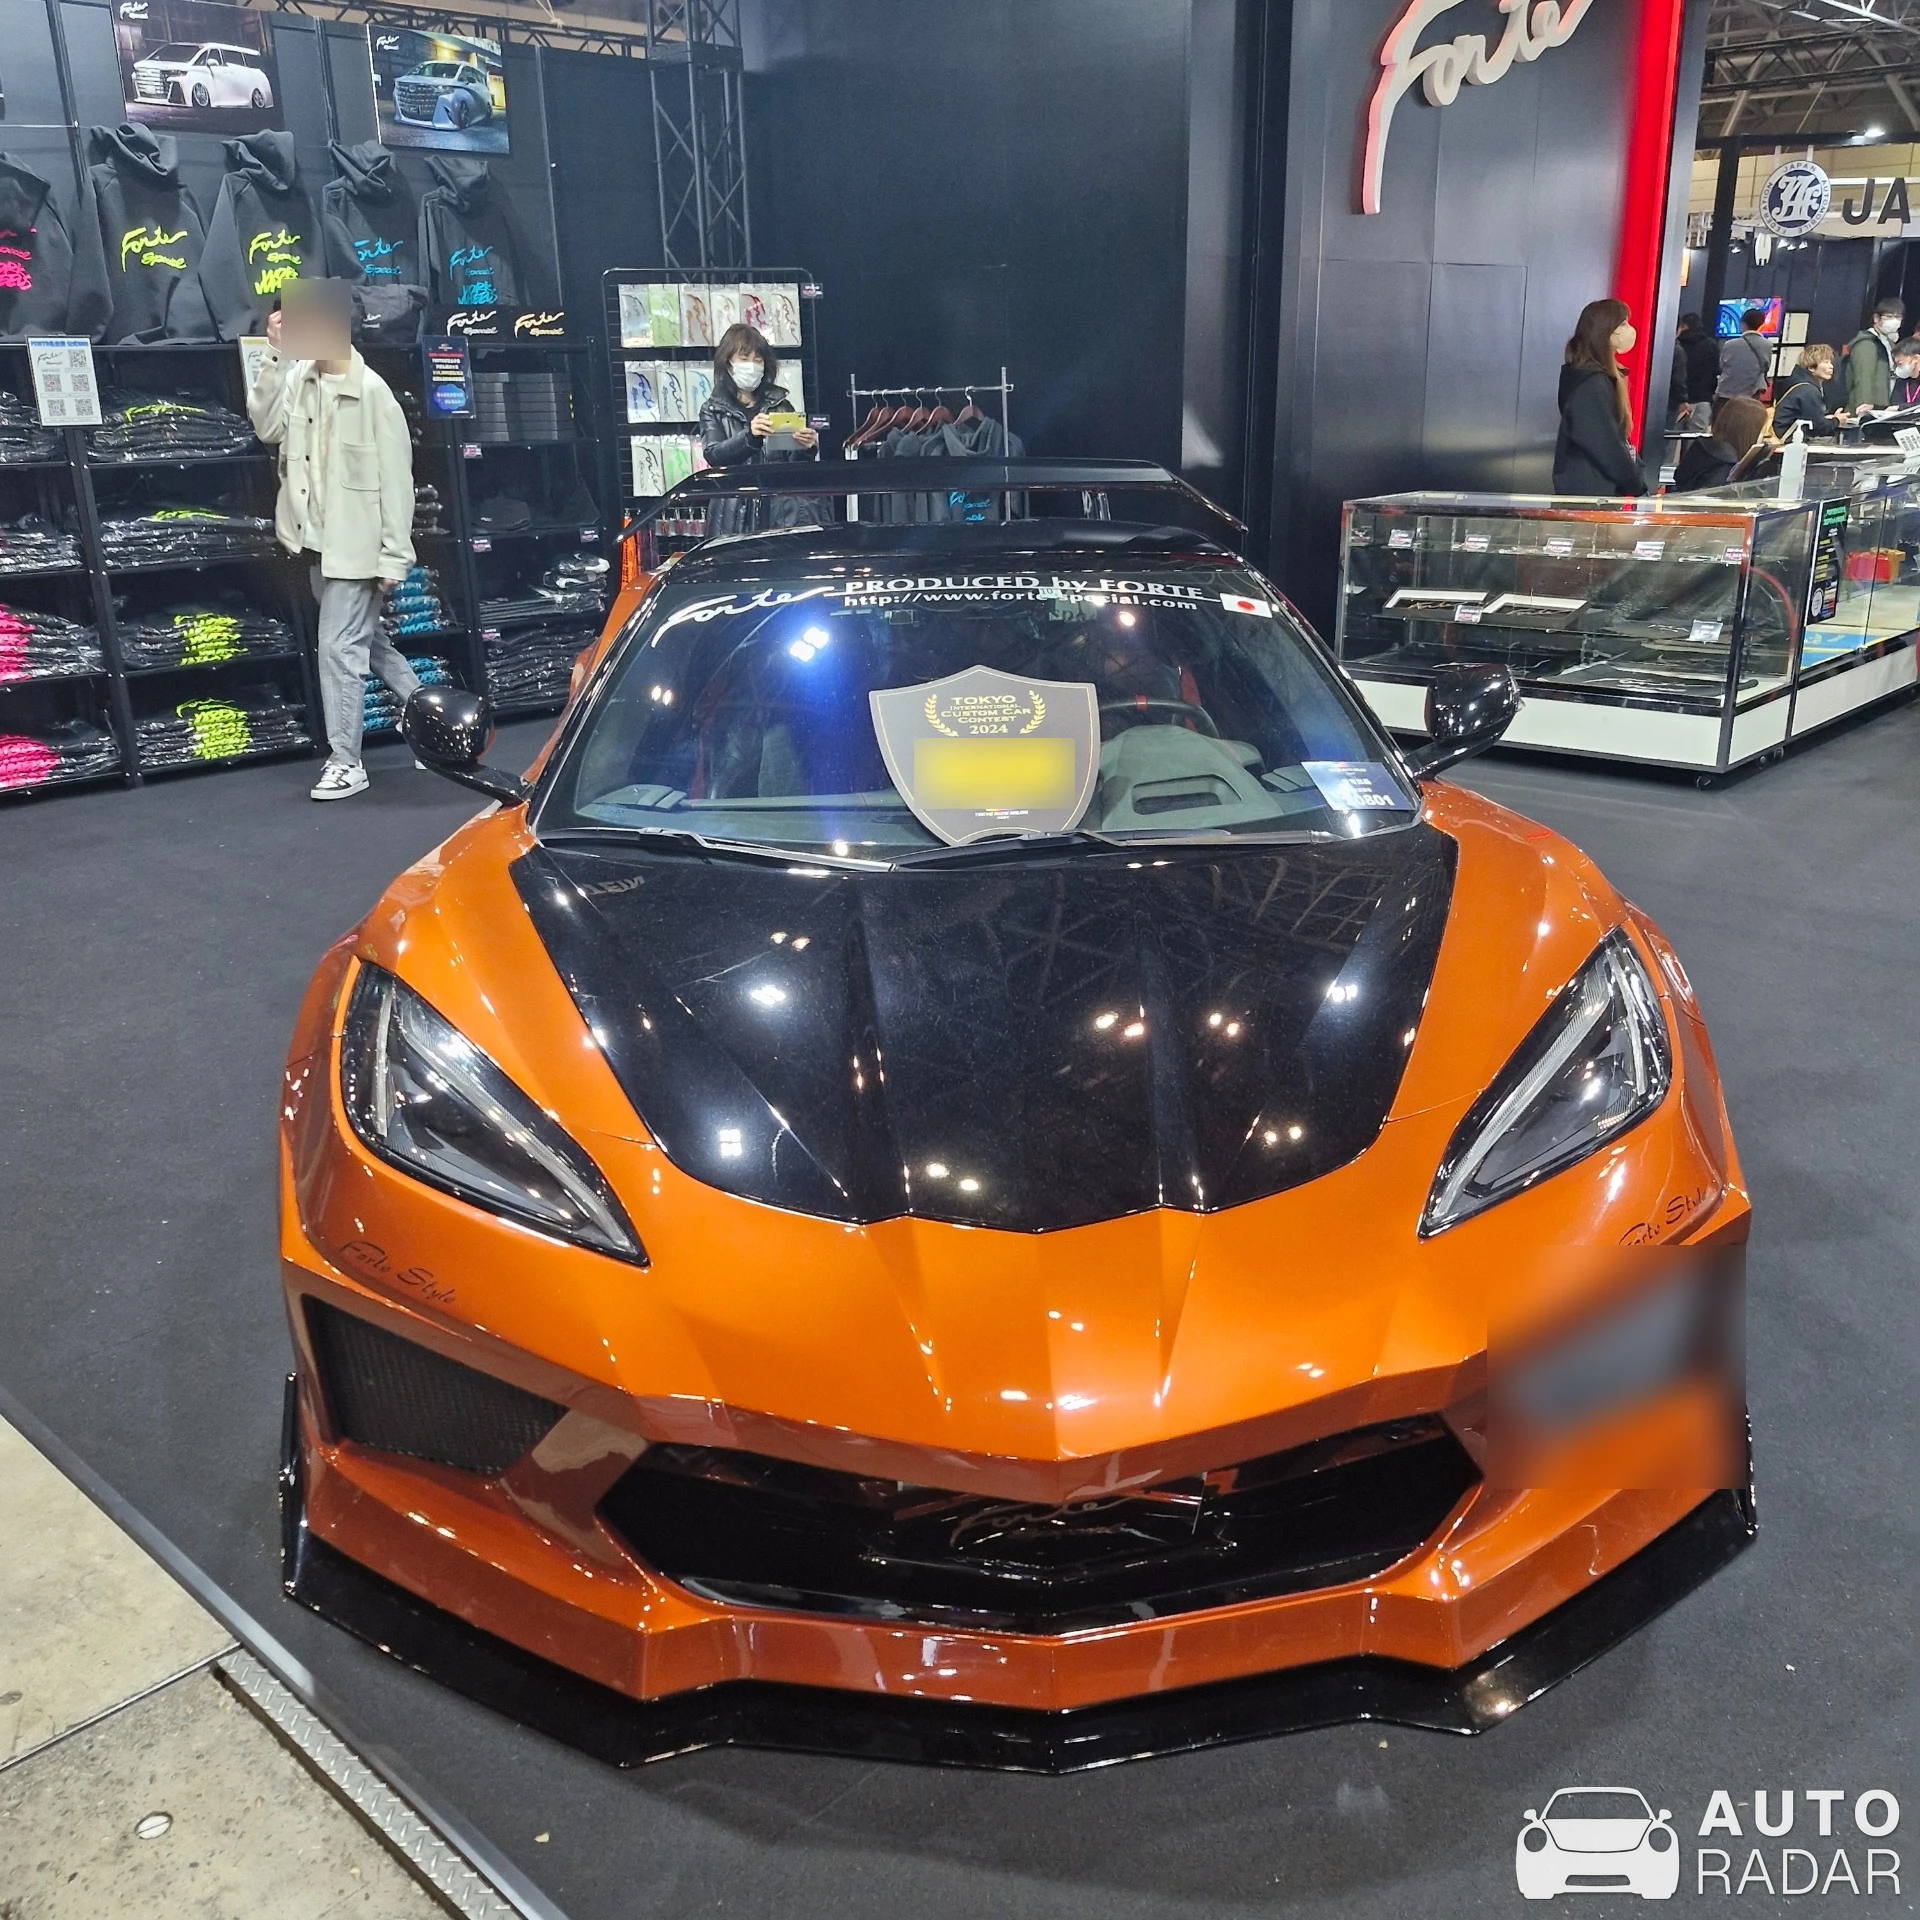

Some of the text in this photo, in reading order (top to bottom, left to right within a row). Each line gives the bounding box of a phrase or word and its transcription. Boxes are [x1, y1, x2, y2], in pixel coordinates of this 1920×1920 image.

[1783, 162, 1817, 173] JAPAN
[121, 226, 188, 273] Forte
[249, 229, 301, 264] Forte
[446, 310, 497, 337] Forte
[514, 312, 565, 338] Forte
[844, 576, 1203, 600] PRODUCED by FORTE
[951, 695, 1017, 705] TOKYO
[950, 703, 1021, 711] INTERNATIONAL
[941, 710, 998, 718] CUSTOM
[958, 715, 1016, 723] CONTEST
[969, 724, 1008, 735] 2024
